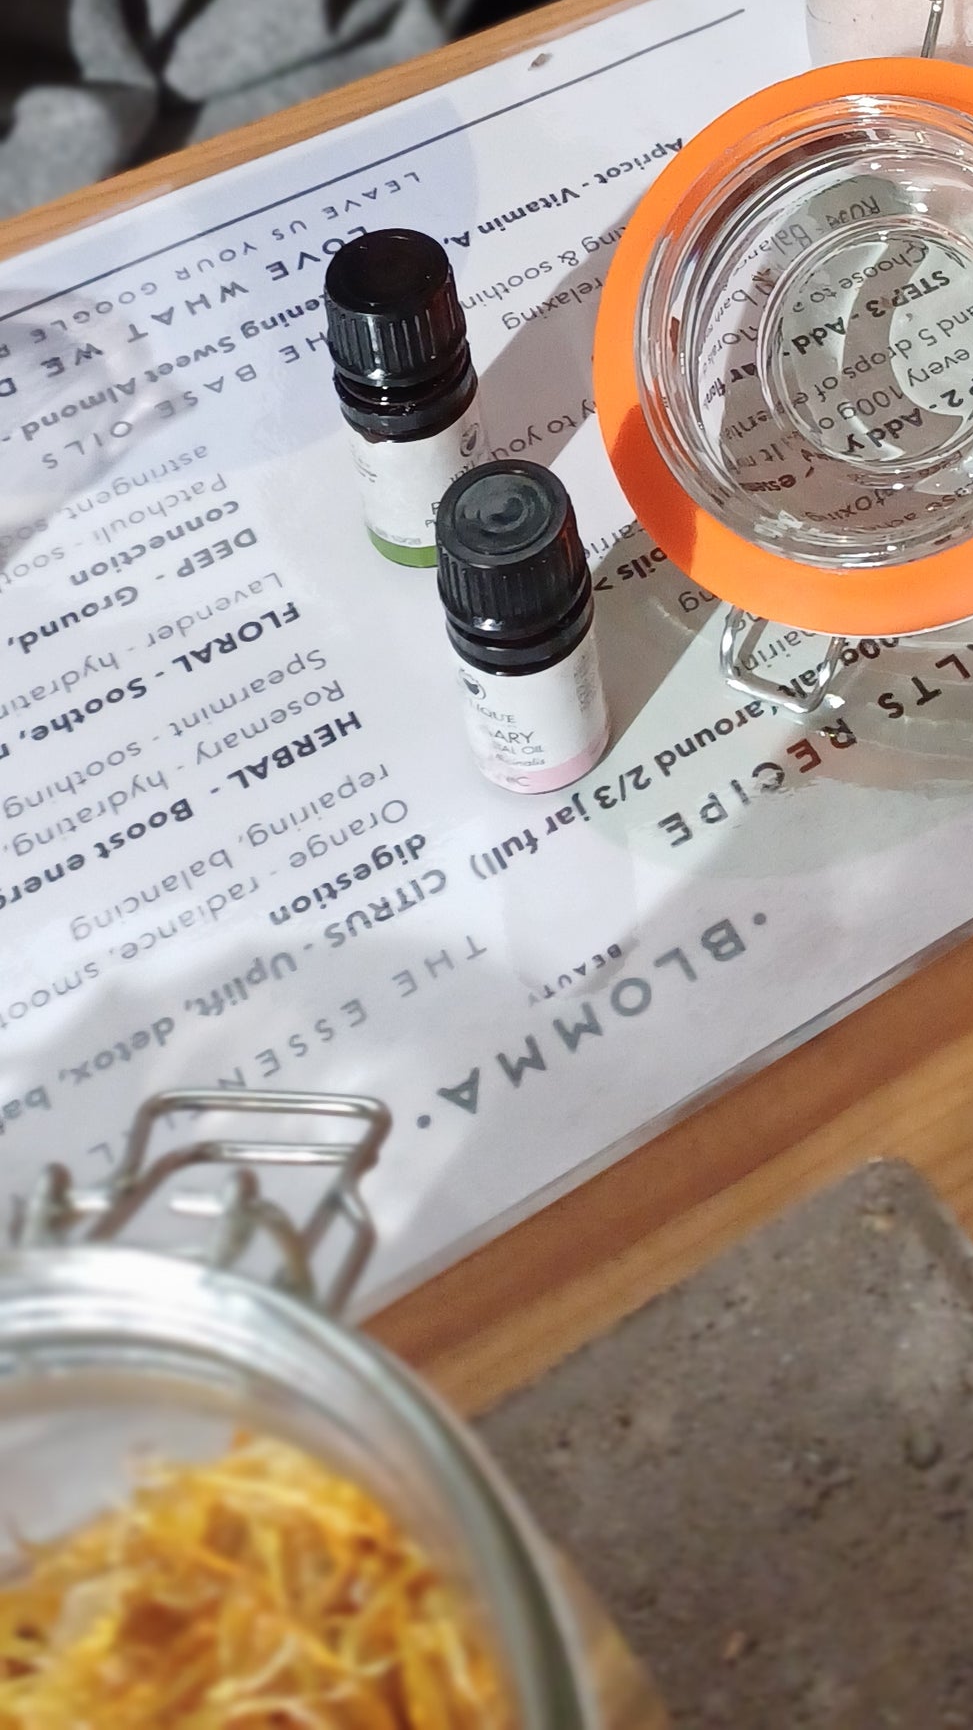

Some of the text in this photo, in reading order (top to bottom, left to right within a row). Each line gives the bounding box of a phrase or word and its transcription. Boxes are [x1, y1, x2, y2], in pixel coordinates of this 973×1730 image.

[321, 171, 421, 220] LEAVE
[594, 138, 684, 193] Apricot
[270, 220, 308, 242] US
[477, 187, 580, 238] Vitamin
[173, 240, 257, 282] YOUR
[557, 250, 580, 267] &
[839, 242, 929, 290] Choose
[892, 270, 950, 307] STEP
[29, 282, 158, 344] GOOGLE
[127, 281, 249, 344] WHAT
[501, 277, 603, 332] relaxing
[866, 300, 886, 318] 3
[40, 342, 103, 378] WE
[144, 336, 236, 383] Sweet
[791, 317, 846, 355] Add
[842, 339, 912, 380] drops
[918, 328, 937, 346] 5
[815, 377, 838, 402] of
[907, 349, 970, 387] every
[21, 377, 135, 442] Almond
[42, 332, 327, 469] HE BASE OILS
[546, 415, 577, 436] to
[837, 384, 903, 419] 100g
[865, 408, 923, 448] Add
[93, 473, 227, 546] Patchouli
[69, 500, 239, 586] connection
[176, 528, 258, 578] DEEP
[8, 586, 138, 654] Ground,
[146, 572, 283, 649] Lavender
[171, 601, 300, 673] FLORAL
[19, 677, 147, 741] Soothe,
[169, 649, 327, 738] Spearmint
[195, 680, 345, 765] Rosemary
[3, 742, 142, 819] soothing
[227, 711, 362, 789] HERBAL
[3, 770, 168, 857] hydrating,
[546, 793, 591, 833] jar
[593, 765, 652, 810] 2/3
[657, 718, 857, 848] RECIPE
[69, 763, 389, 941] repairing, balancing
[93, 798, 194, 859] Boost
[288, 799, 408, 870] Orange
[469, 828, 538, 880] full)
[269, 834, 426, 927] digestion
[324, 869, 446, 948] CITRUS
[108, 877, 259, 961] radiance,
[184, 952, 297, 1017] Uplift,
[391, 935, 487, 997] THE
[527, 944, 622, 1007] BEAUTY
[438, 919, 745, 1114] BLOMMA
[58, 1017, 175, 1086] detox,
